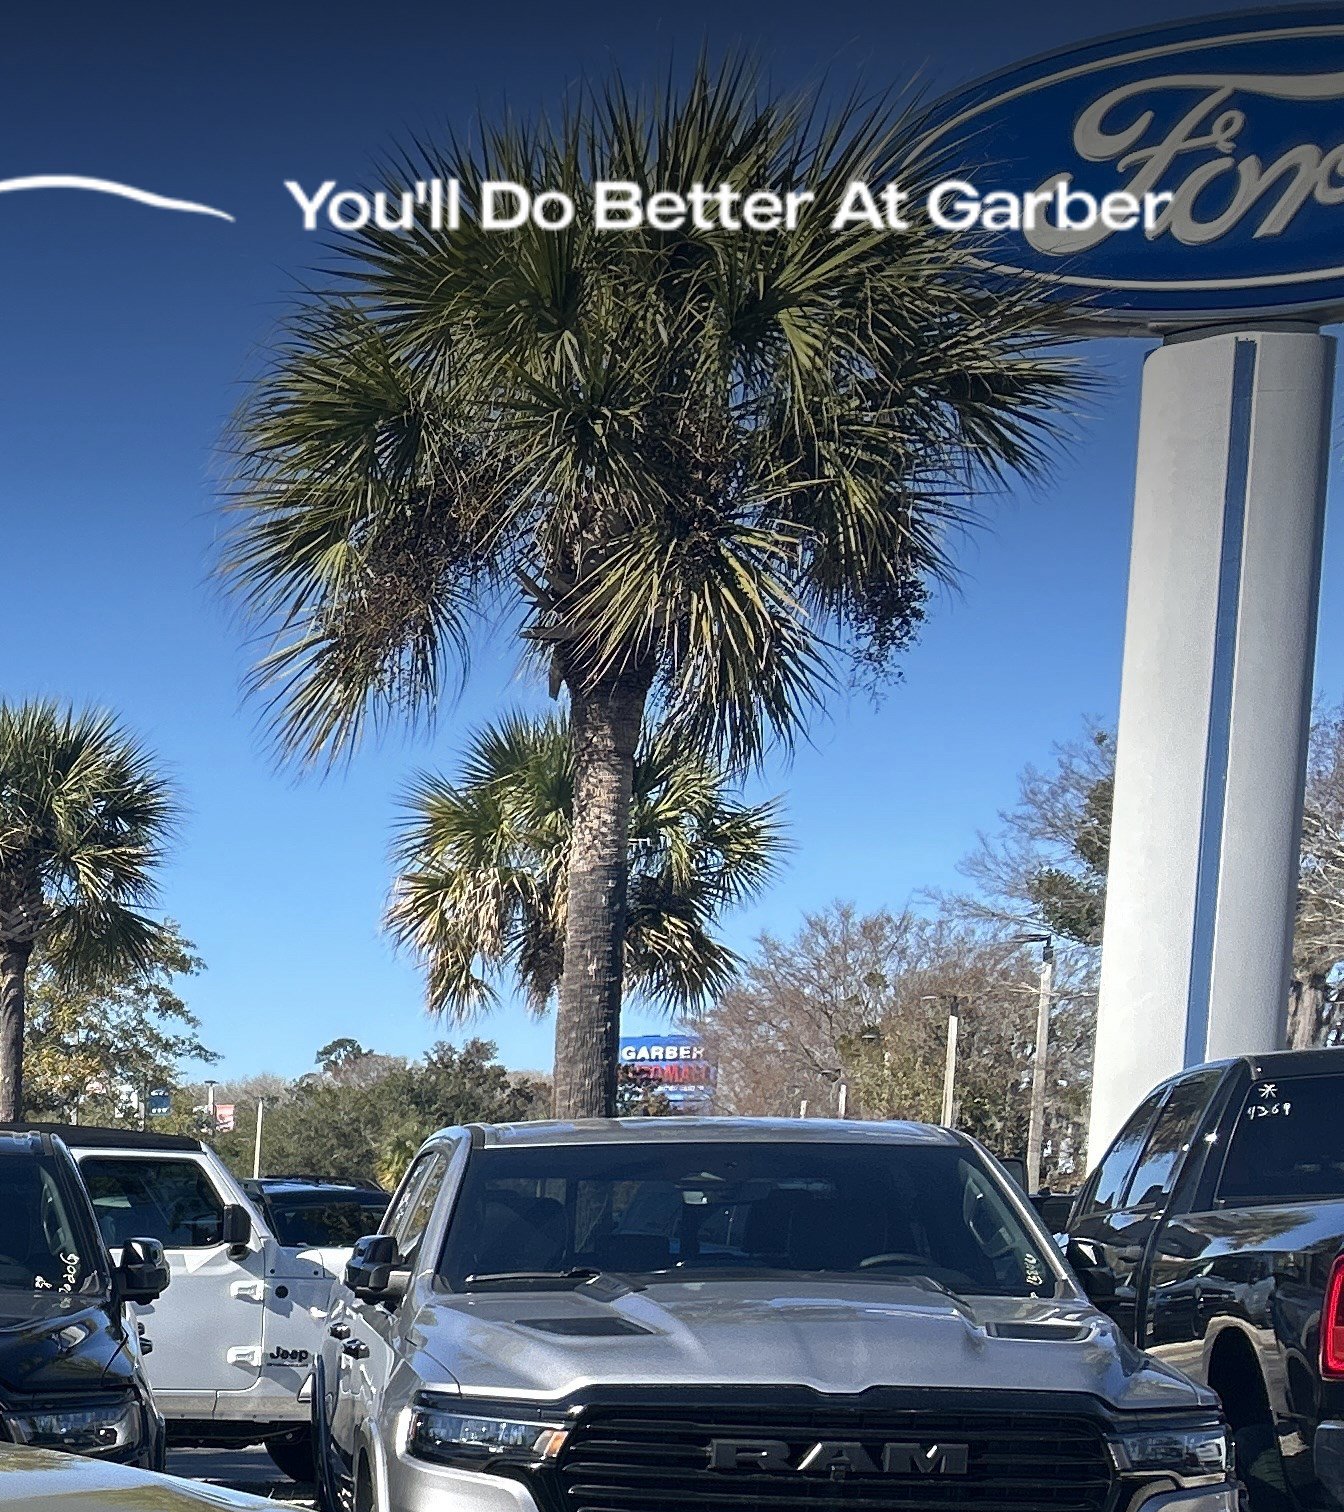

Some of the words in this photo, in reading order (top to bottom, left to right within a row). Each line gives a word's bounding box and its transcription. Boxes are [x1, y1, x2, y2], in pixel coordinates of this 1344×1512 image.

[1023, 72, 1344, 257] For
[269, 1346, 309, 1363] Jeep
[707, 1438, 969, 1474] RAM
